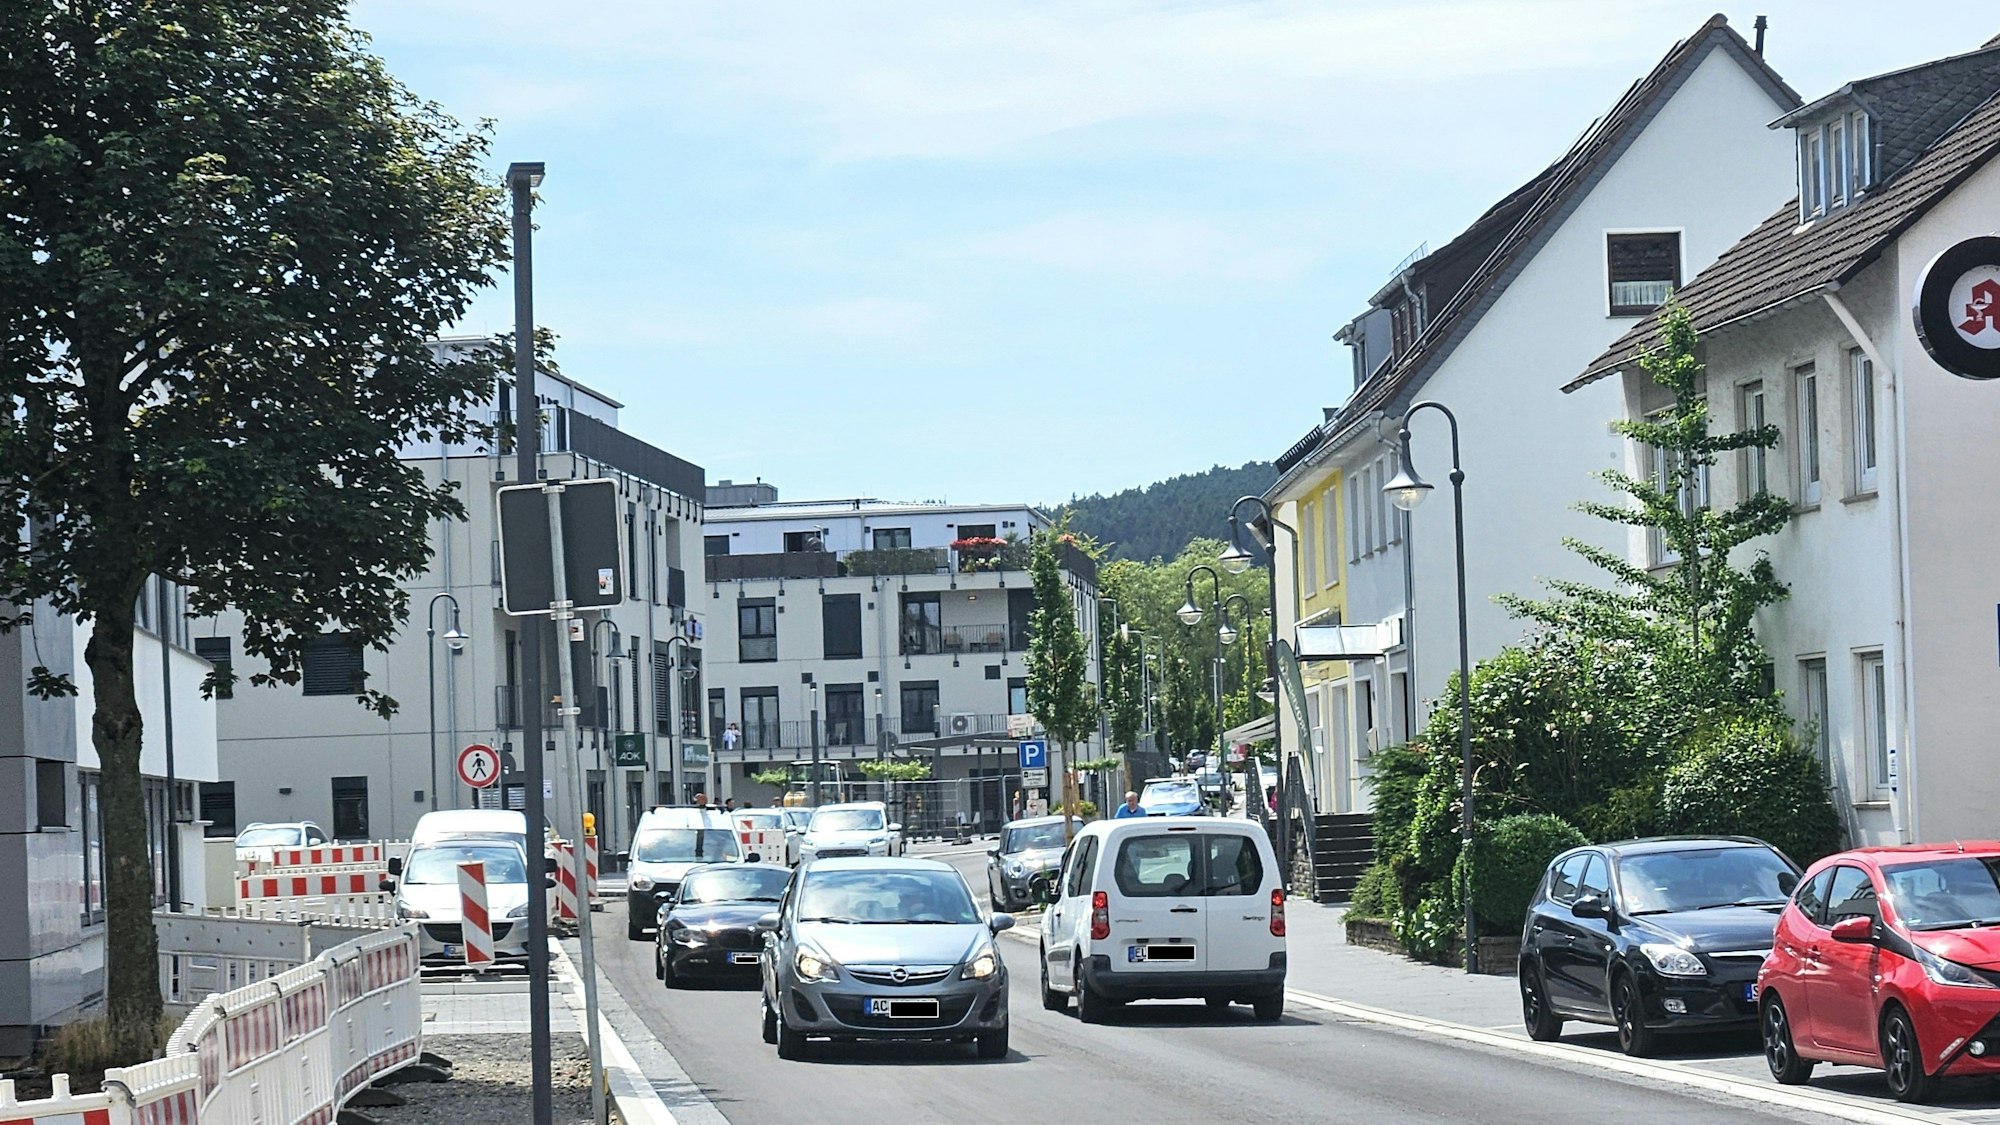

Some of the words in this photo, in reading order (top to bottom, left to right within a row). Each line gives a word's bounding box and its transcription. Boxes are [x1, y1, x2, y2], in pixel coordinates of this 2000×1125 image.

[619, 751, 641, 760] AOK
[1025, 744, 1040, 765] P
[872, 1000, 888, 1012] AC
